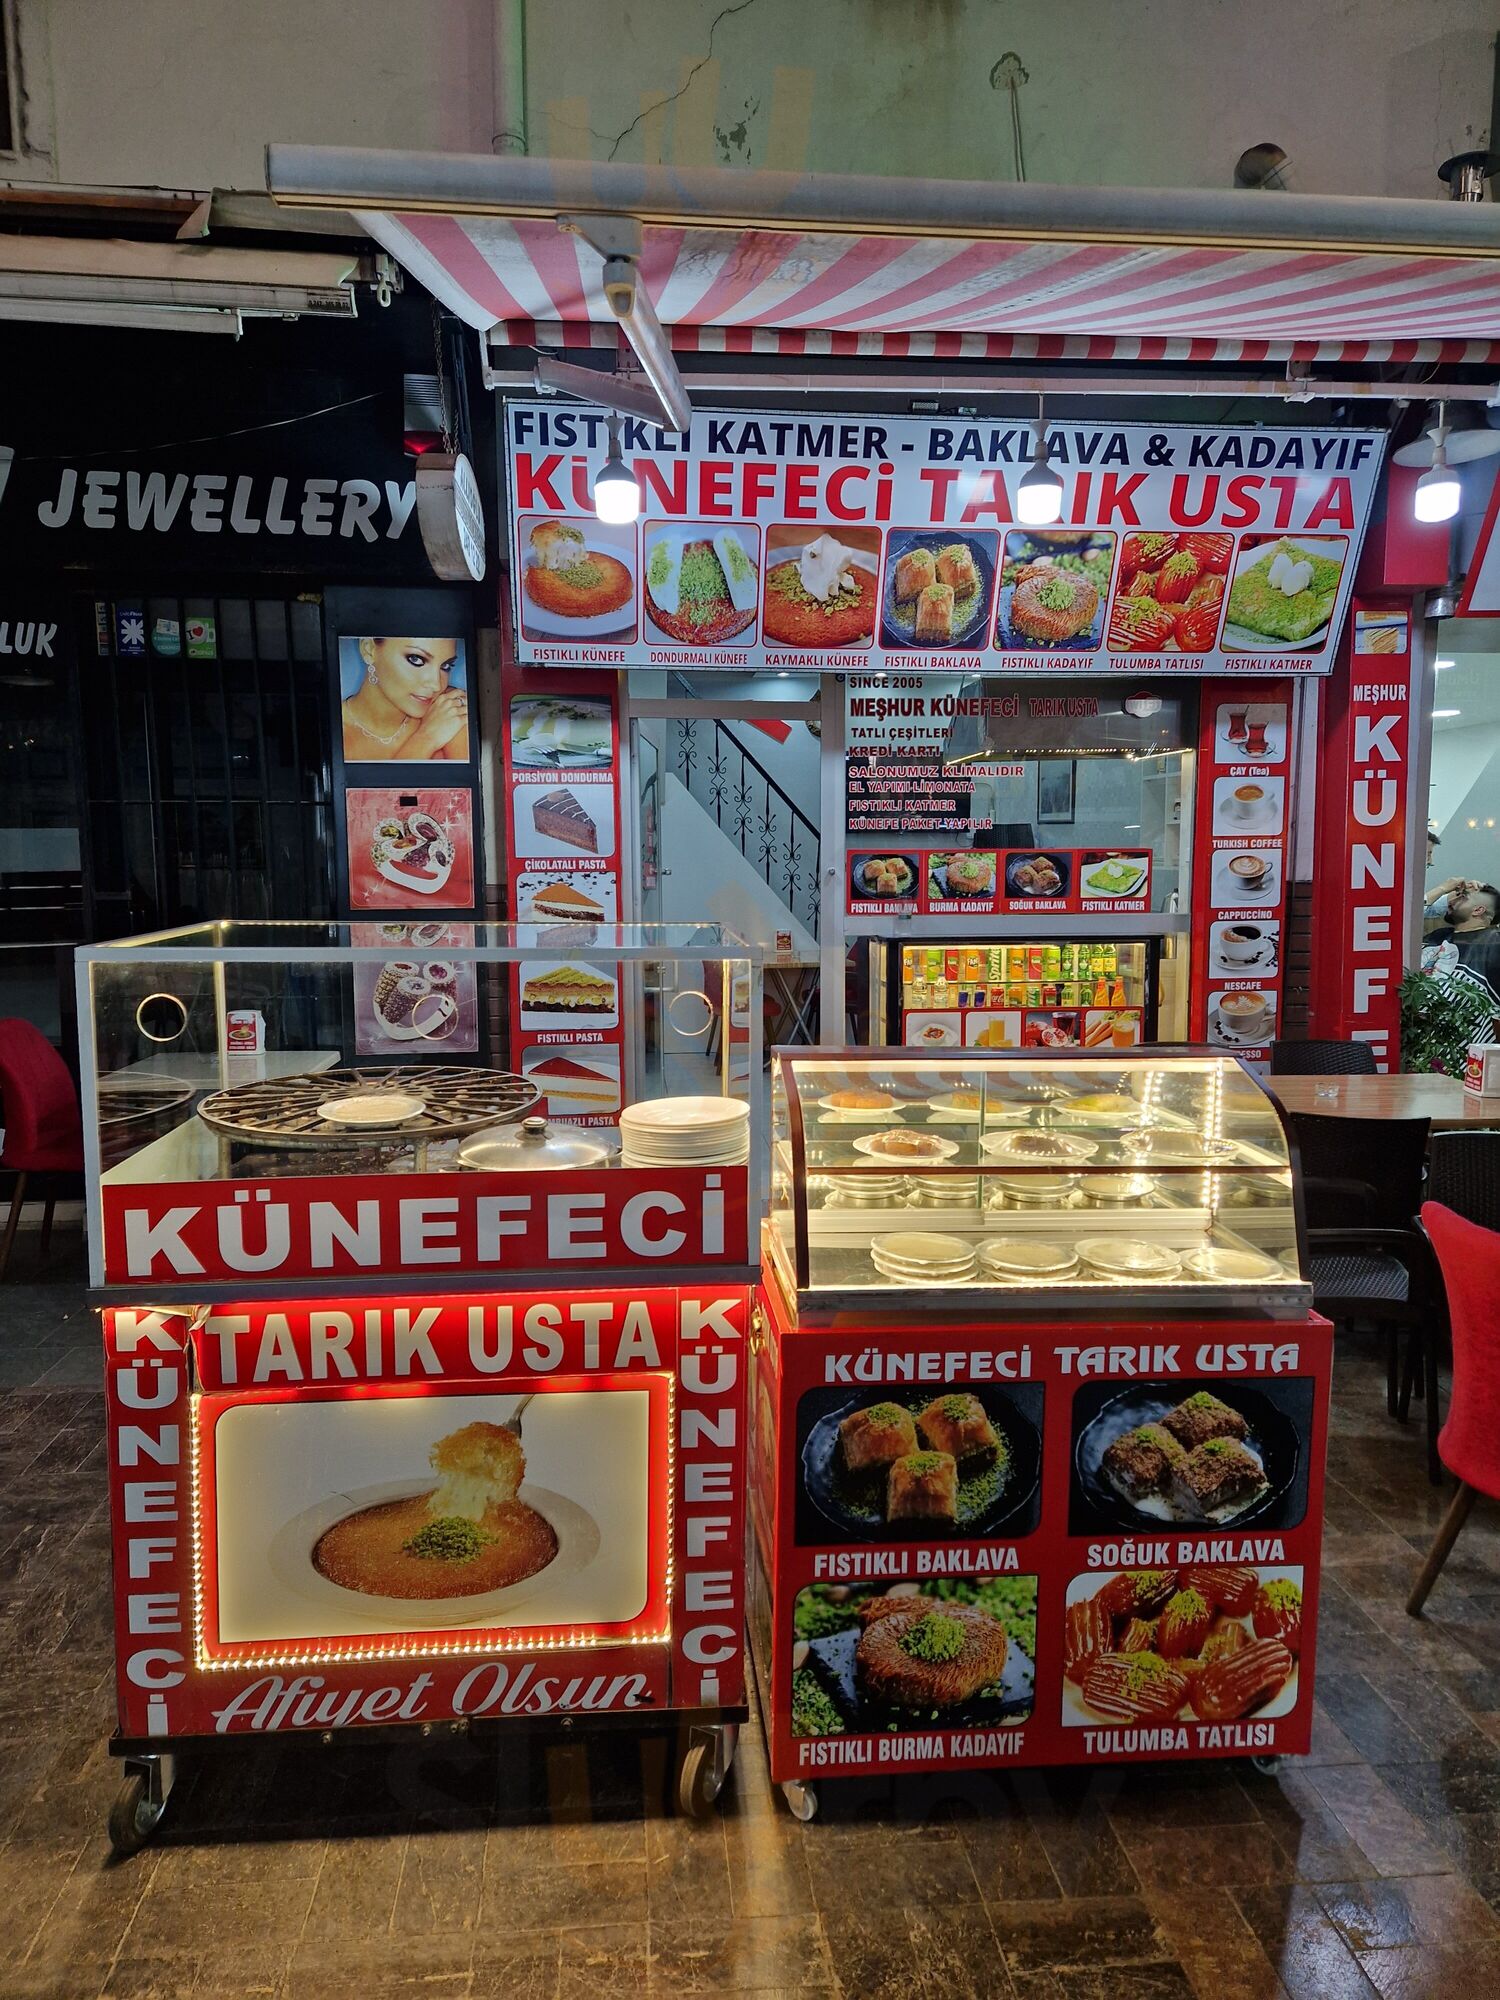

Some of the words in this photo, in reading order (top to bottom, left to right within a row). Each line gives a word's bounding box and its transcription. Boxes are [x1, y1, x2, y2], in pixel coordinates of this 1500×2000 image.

[708, 420, 888, 460] KATMER
[928, 427, 1130, 465] BAKLAVA
[1142, 433, 1175, 467] &
[1188, 435, 1374, 470] KADAYIF
[37, 468, 416, 543] JEWELLERY
[920, 467, 1150, 526] TAIK
[1169, 473, 1355, 530] USTA
[533, 648, 579, 661] FISTIKLI
[582, 646, 626, 662] KÜNEFE
[650, 651, 712, 665] DONDURMALI
[713, 650, 748, 666] KÜNEFE
[765, 653, 823, 667] KAYMAKLI
[827, 652, 869, 668] KÜNEFE
[885, 656, 927, 667] FISTIKLI
[930, 656, 982, 668] BAKLAVA
[1002, 657, 1044, 669] FISTIKLI
[1048, 657, 1094, 669] KADAYIF
[1109, 658, 1161, 669] TULUMBA
[1165, 658, 1204, 669] TATLISI
[1225, 658, 1266, 670] FISTIKLI
[1269, 659, 1313, 670] KATMER
[849, 676, 889, 689] SINCE
[892, 676, 923, 689] 2005
[1353, 684, 1407, 706] MEŞHUR
[850, 696, 925, 721] MEŞHUR
[930, 692, 1020, 718] KÜNEFECİ
[1028, 697, 1065, 717] TARIK
[1067, 697, 1100, 717] USTA
[851, 727, 885, 738] TATLI
[849, 744, 893, 757] KREDİ
[896, 745, 941, 757] KARTI
[512, 770, 558, 783] PORSİYON
[561, 772, 613, 783] DONDURMA
[848, 765, 939, 778] SALONUMUZ
[942, 763, 1024, 778] KLİMALIDIR
[1249, 766, 1270, 776] (Tea)
[848, 781, 865, 793] EL
[867, 781, 911, 793] YAPIMI
[913, 779, 976, 793] LİMONATA
[848, 799, 902, 812] FISTIKLI
[905, 799, 956, 812] KATMER
[848, 816, 899, 830] KÜNEFE
[902, 817, 942, 830] PAKET
[945, 817, 993, 830] YAPILIR
[1212, 839, 1248, 848] TURKISH
[1250, 839, 1283, 848] COFFEE
[525, 859, 576, 872] ÇİKOLATALI
[579, 859, 607, 870] PASTA
[851, 902, 882, 914] FISTIKLI
[929, 901, 959, 913] BURMA
[961, 901, 994, 913] KADAYIF
[1009, 899, 1034, 910] SOĞUK
[1035, 899, 1067, 910] BAKLAVA
[1082, 901, 1113, 911] FISTIKLI
[1114, 901, 1145, 911] KATMER
[1225, 981, 1261, 990] NESCAFE
[537, 1033, 573, 1043] FISTIKLI
[576, 1033, 603, 1043] PASTA
[588, 1116, 615, 1126] PASTA
[124, 1174, 724, 1276] KÜNEFECİ
[205, 1308, 444, 1384] TARIK
[467, 1301, 662, 1374] USTA
[824, 1344, 1032, 1383] KÜNEFECİ
[1053, 1345, 1180, 1377] TARIK
[1195, 1343, 1300, 1374] USTA
[680, 1299, 743, 1707] KÜNEFECİ
[114, 1310, 188, 1737] KÜNEFECİ
[1087, 1538, 1170, 1567] SOĞUK
[1178, 1539, 1285, 1564] BAKLAVA
[814, 1551, 908, 1577] FISTIKLI
[917, 1548, 1019, 1573] BAKLAVA
[211, 1673, 434, 1733] Afiyet
[452, 1662, 652, 1717] Olsun
[1083, 1728, 1189, 1754] TULUMBA
[1197, 1724, 1275, 1749] TATLISI
[799, 1740, 872, 1766] FISTIKLI
[878, 1736, 944, 1762] BURMA
[950, 1732, 1025, 1758] KADAYIF
